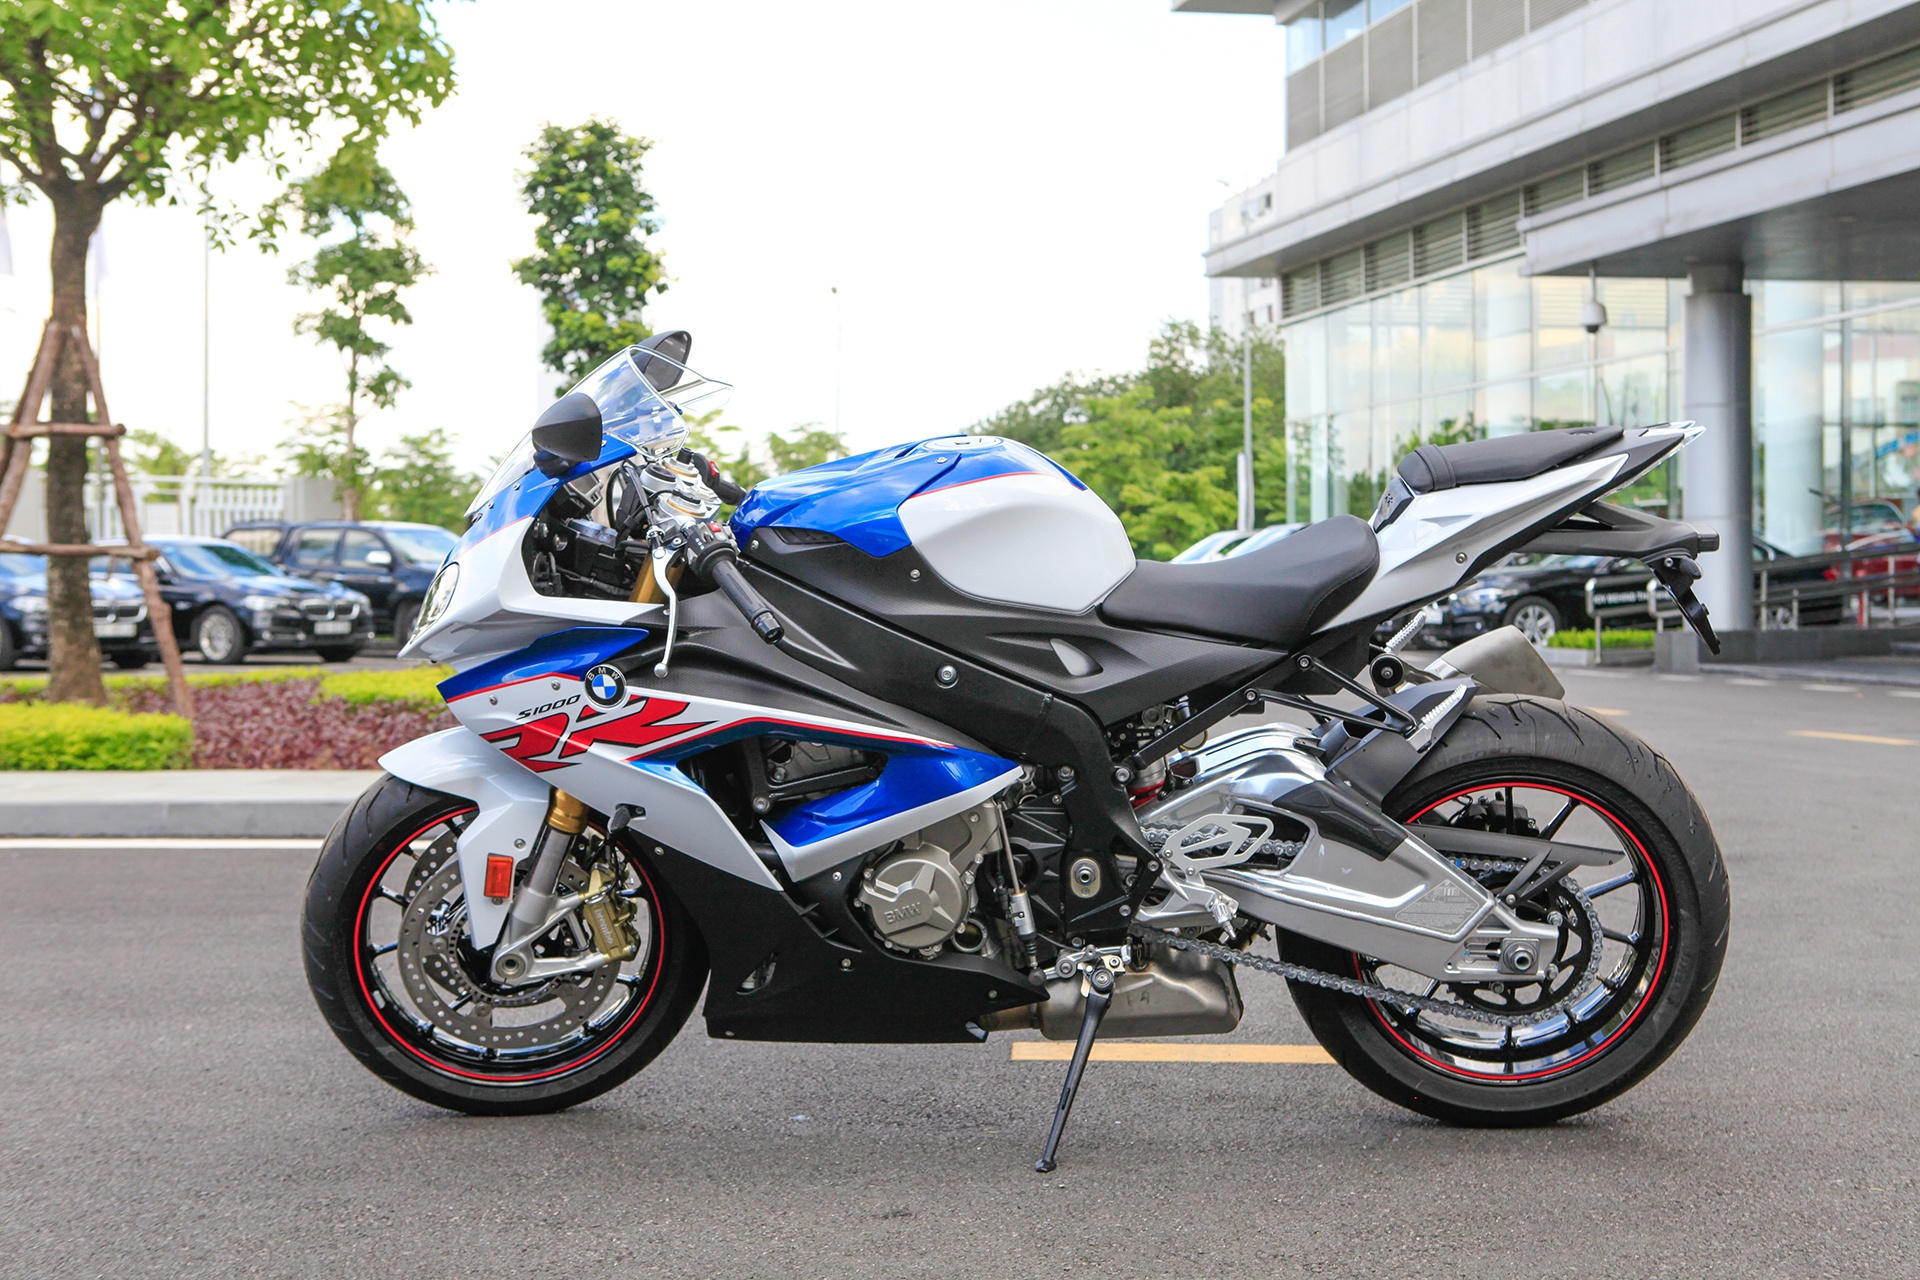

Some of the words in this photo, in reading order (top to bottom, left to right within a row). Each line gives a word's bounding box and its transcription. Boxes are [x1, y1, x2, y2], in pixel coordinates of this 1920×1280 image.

[587, 667, 620, 681] BMW
[516, 694, 581, 720] S1000
[884, 902, 921, 923] BMW
[594, 908, 614, 945] brembo
